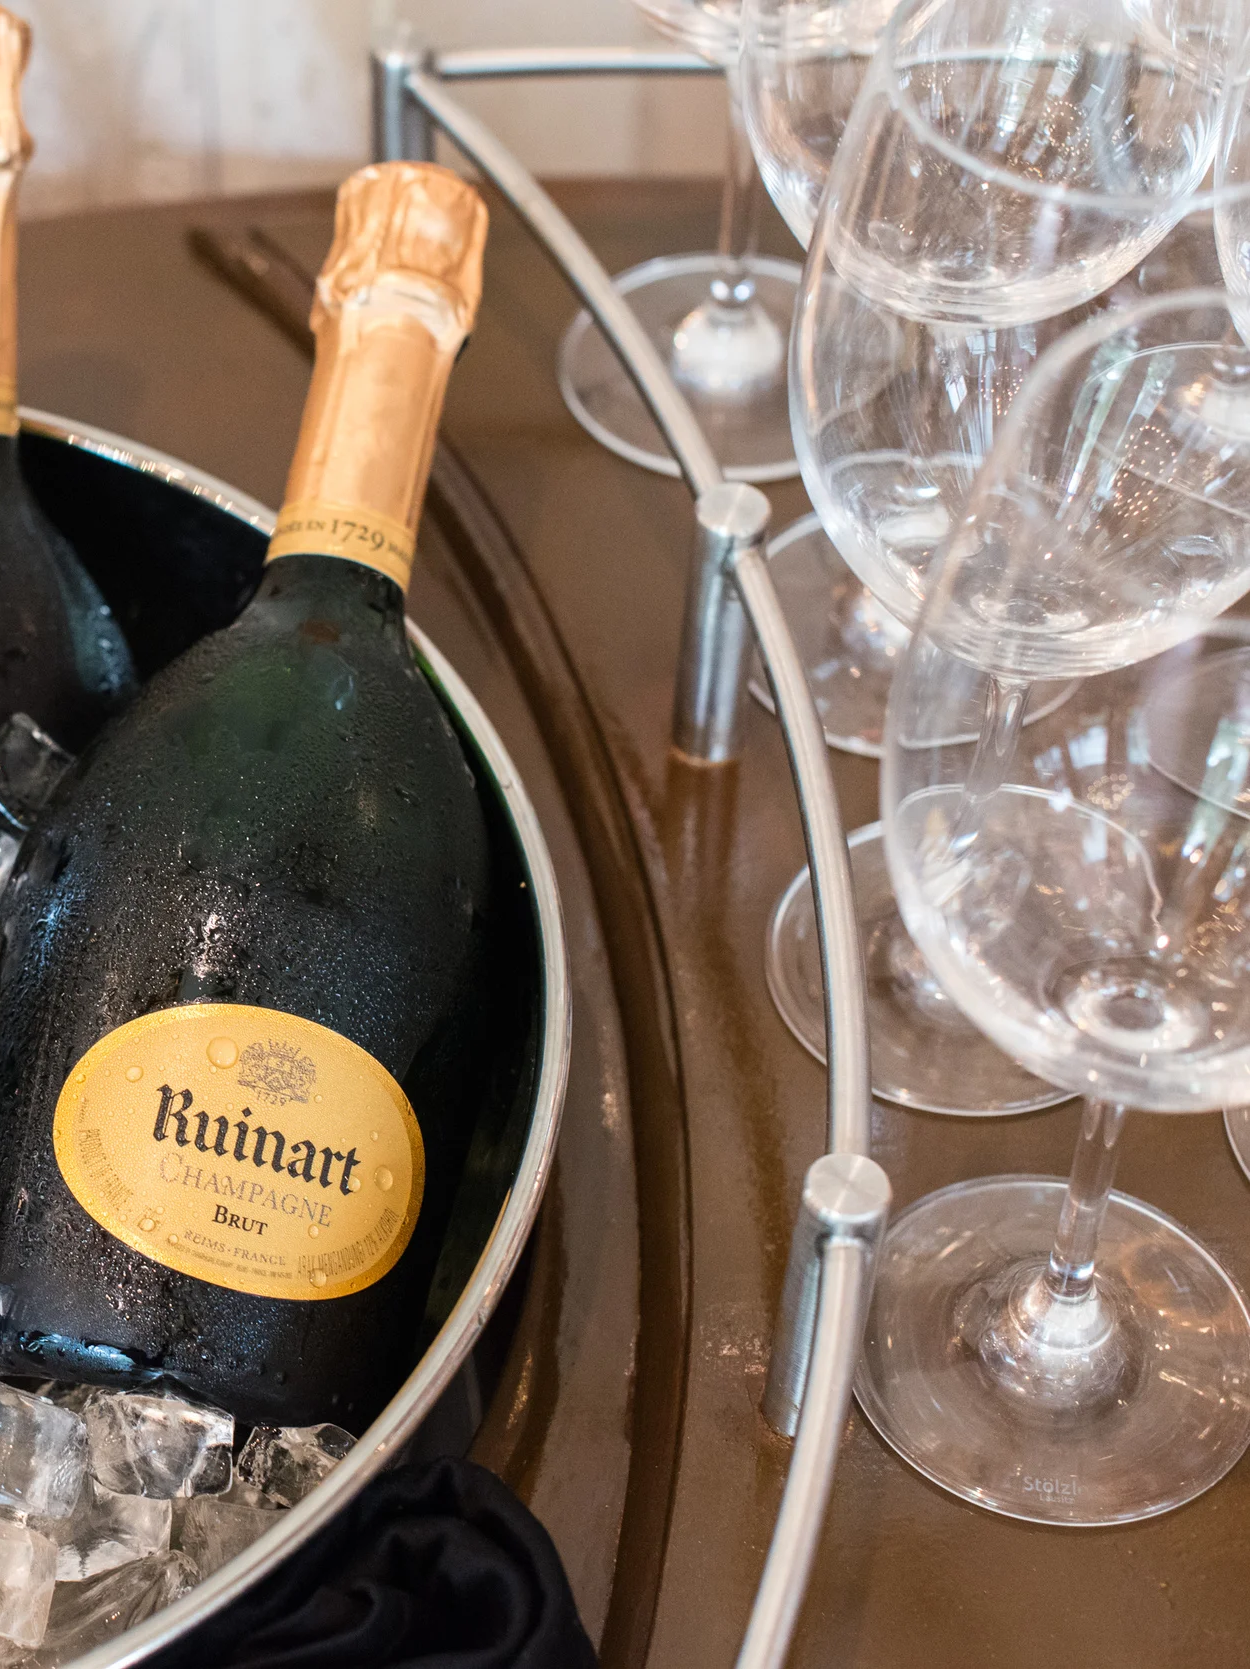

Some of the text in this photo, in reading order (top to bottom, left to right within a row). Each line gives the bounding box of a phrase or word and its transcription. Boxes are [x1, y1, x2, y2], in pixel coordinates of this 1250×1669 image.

[331, 519, 385, 550] 1729
[153, 1084, 361, 1196] Ruinart
[160, 1152, 333, 1228] CHAMPAGNE
[183, 1229, 227, 1254] REIMS
[233, 1247, 286, 1267] FRANCE
[1023, 1475, 1083, 1496] Stölzl
